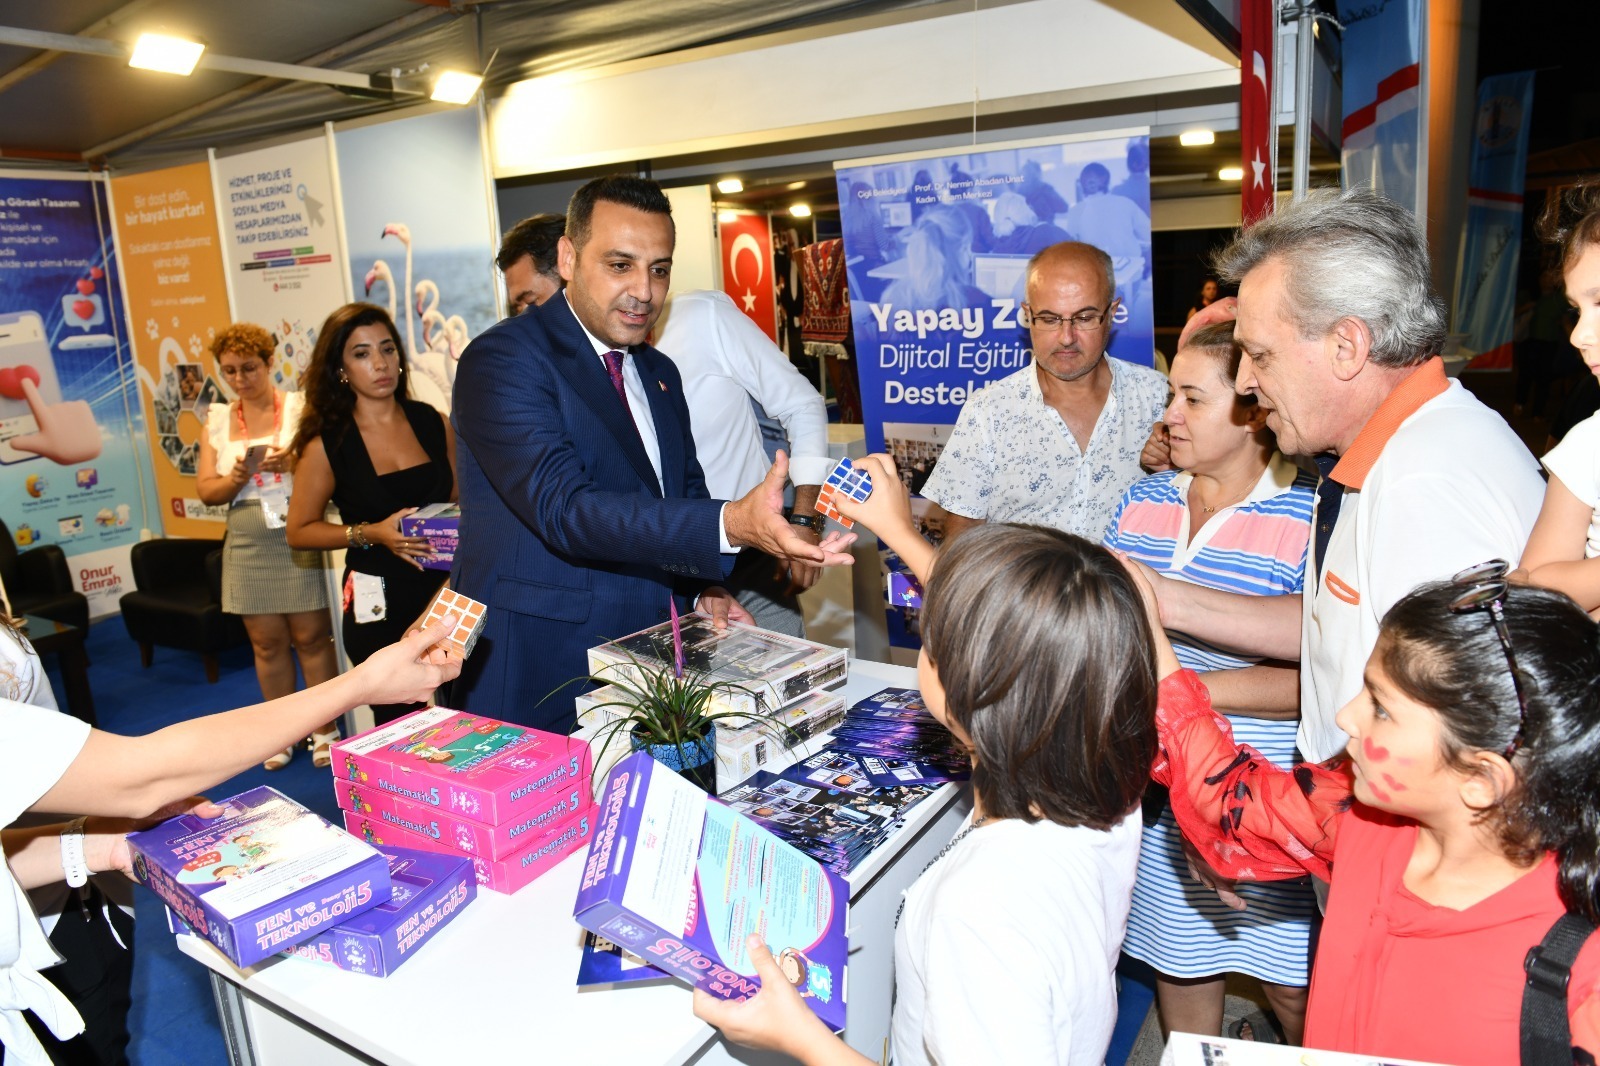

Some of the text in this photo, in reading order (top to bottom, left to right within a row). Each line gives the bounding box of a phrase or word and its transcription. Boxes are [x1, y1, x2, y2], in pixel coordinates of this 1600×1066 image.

[257, 171, 281, 183] PROJE
[282, 168, 292, 178] VE
[914, 174, 1025, 193] Prof. Dr. Nermin Abadan Unat
[7, 198, 40, 207] Görsel
[41, 198, 80, 208] Tasarım
[134, 194, 146, 208] Bir
[148, 191, 166, 206] dost
[916, 190, 993, 204] Kadın Yam Merkezi
[125, 201, 205, 226] bir hayat kurtar!
[232, 200, 286, 217] SOSYAL MEDYA
[31, 224, 42, 232] ve
[235, 213, 302, 231] HESAPLARIMIZDAN
[236, 231, 256, 245] TAKİP
[870, 303, 984, 340] Yapay
[880, 344, 950, 376] Dijital
[80, 566, 114, 582] Onur
[82, 574, 122, 592] Emrah
[510, 765, 568, 802] Matematik
[570, 756, 580, 776] 5
[509, 800, 568, 840] Matematik
[570, 790, 580, 812] 5
[171, 835, 216, 856] FEN
[522, 827, 577, 868] Matematik
[580, 816, 590, 838] 5
[254, 908, 292, 937] FEN
[295, 902, 316, 917] ve
[396, 912, 420, 942] FEN
[420, 904, 434, 919] ve
[709, 981, 732, 998] ve
[810, 969, 829, 992] 5
